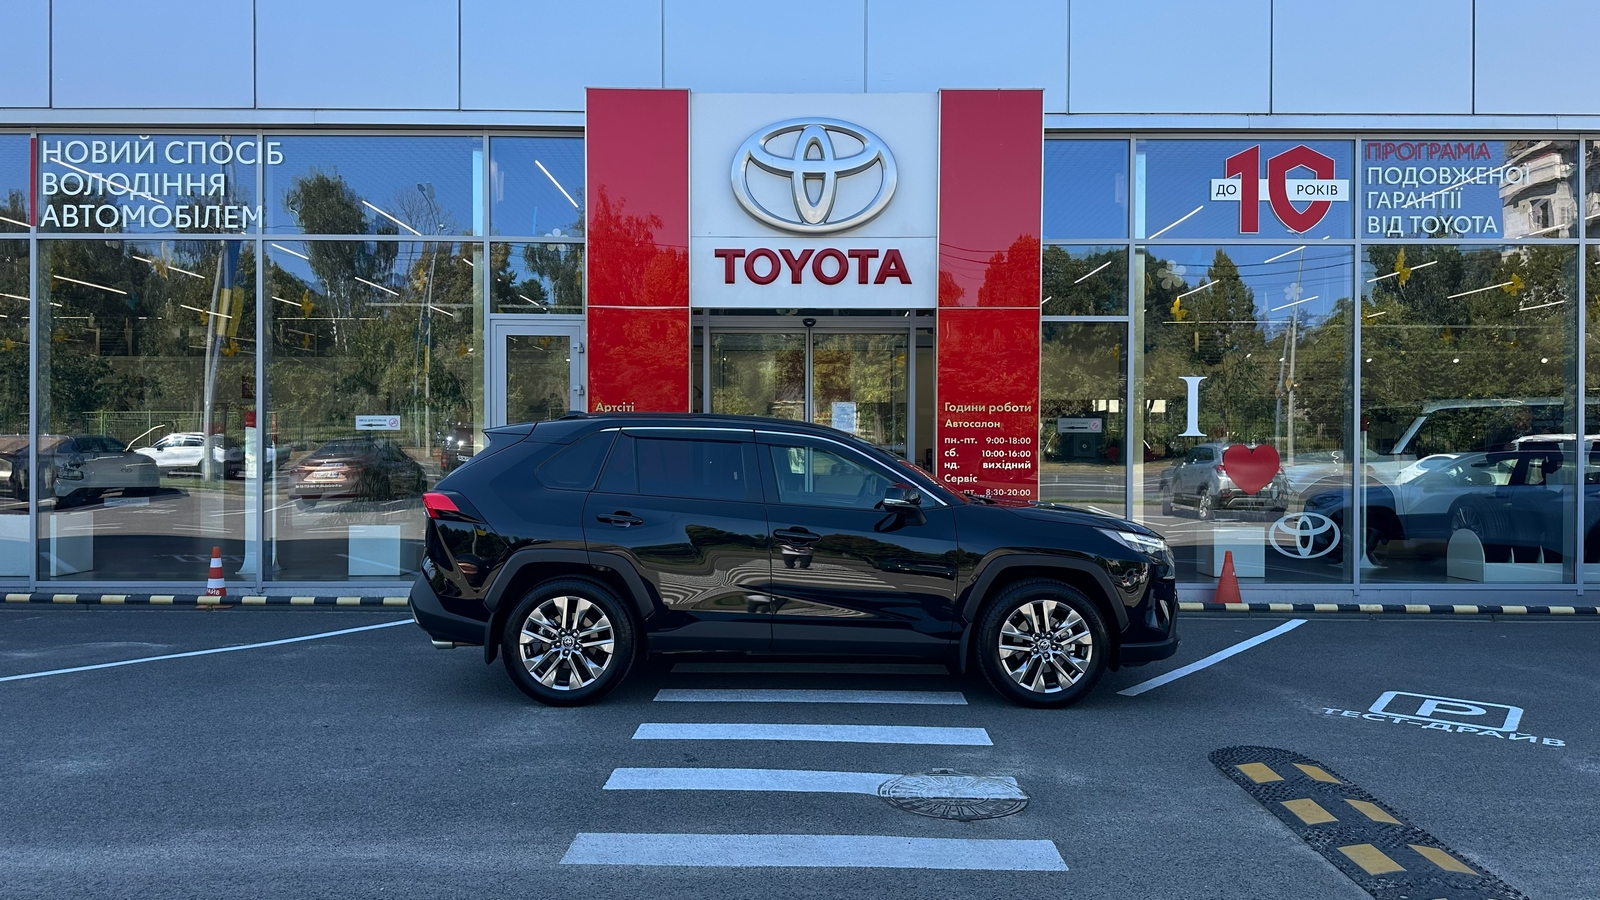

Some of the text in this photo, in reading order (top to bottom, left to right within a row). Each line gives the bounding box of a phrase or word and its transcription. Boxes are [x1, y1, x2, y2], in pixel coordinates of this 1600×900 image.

[42, 135, 284, 165] НОВИЙ СПОСІБ
[1367, 142, 1491, 160] ПРОГРАМА
[1367, 162, 1531, 188] ПОДОВЖЕНОЇ
[42, 173, 226, 200] ВОЛОДІННЯ
[1215, 144, 1338, 234] ДО 10 РОКІВ
[1367, 187, 1462, 209] ГАРАНТІЇ
[40, 204, 264, 229] АВТОМОБІЛЕМ
[1368, 215, 1498, 237] ВІД TOYOTA
[714, 248, 912, 285] TOYOTA
[595, 402, 635, 413] Артсіті
[944, 402, 1032, 414] Години роботи
[1178, 376, 1208, 437] I
[944, 420, 1000, 428] Автосалон
[944, 437, 1031, 445] пн.-пт. 9:00-18:00
[944, 449, 1031, 458] сб. 10:00-16:00
[944, 461, 1031, 470] нд. вихідний
[944, 473, 978, 484] Сервіс
[985, 488, 1031, 496] 8:30-20:00
[1415, 699, 1487, 717] P
[1322, 707, 1566, 747] ТЕСТ-ДРАЙВ
